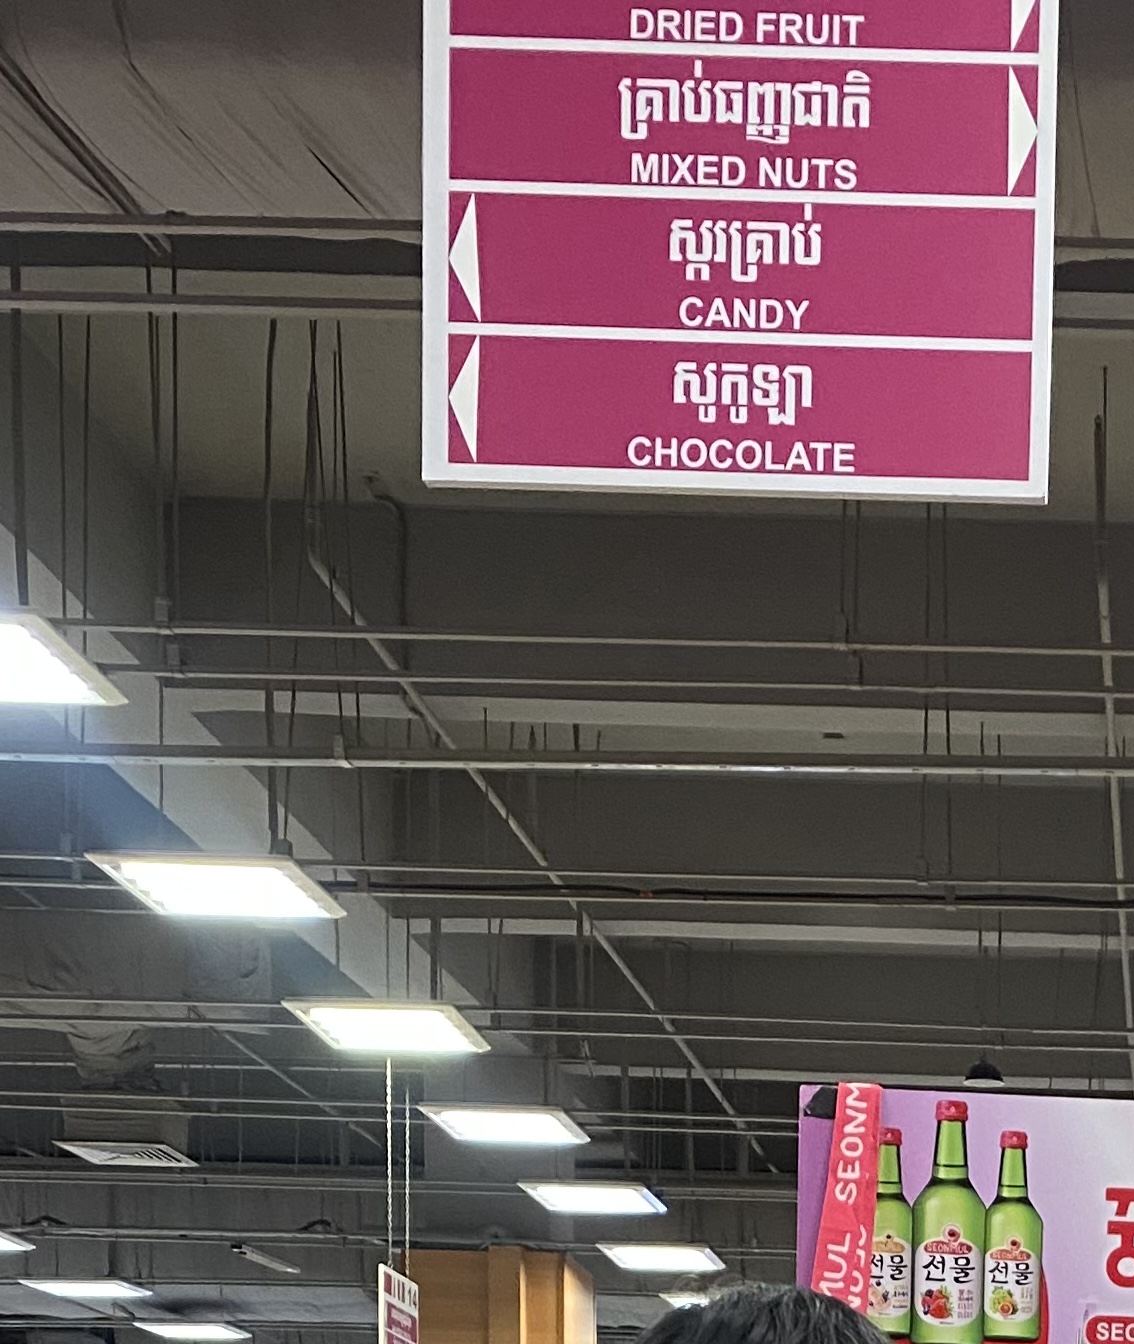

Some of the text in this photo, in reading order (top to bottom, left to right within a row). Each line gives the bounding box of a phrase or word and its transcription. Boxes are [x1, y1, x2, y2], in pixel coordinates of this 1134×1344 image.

[629, 8, 865, 46] DRIED FRUIT
[630, 153, 857, 191] MIXED NUTS
[669, 204, 822, 283] ស្ករគ្រាប់
[679, 297, 810, 330] CANDY
[673, 361, 813, 426] សូកូឡា
[626, 436, 855, 473] CHOCOLATE
[922, 1254, 976, 1284] 선물
[988, 1261, 1034, 1285] 선물
